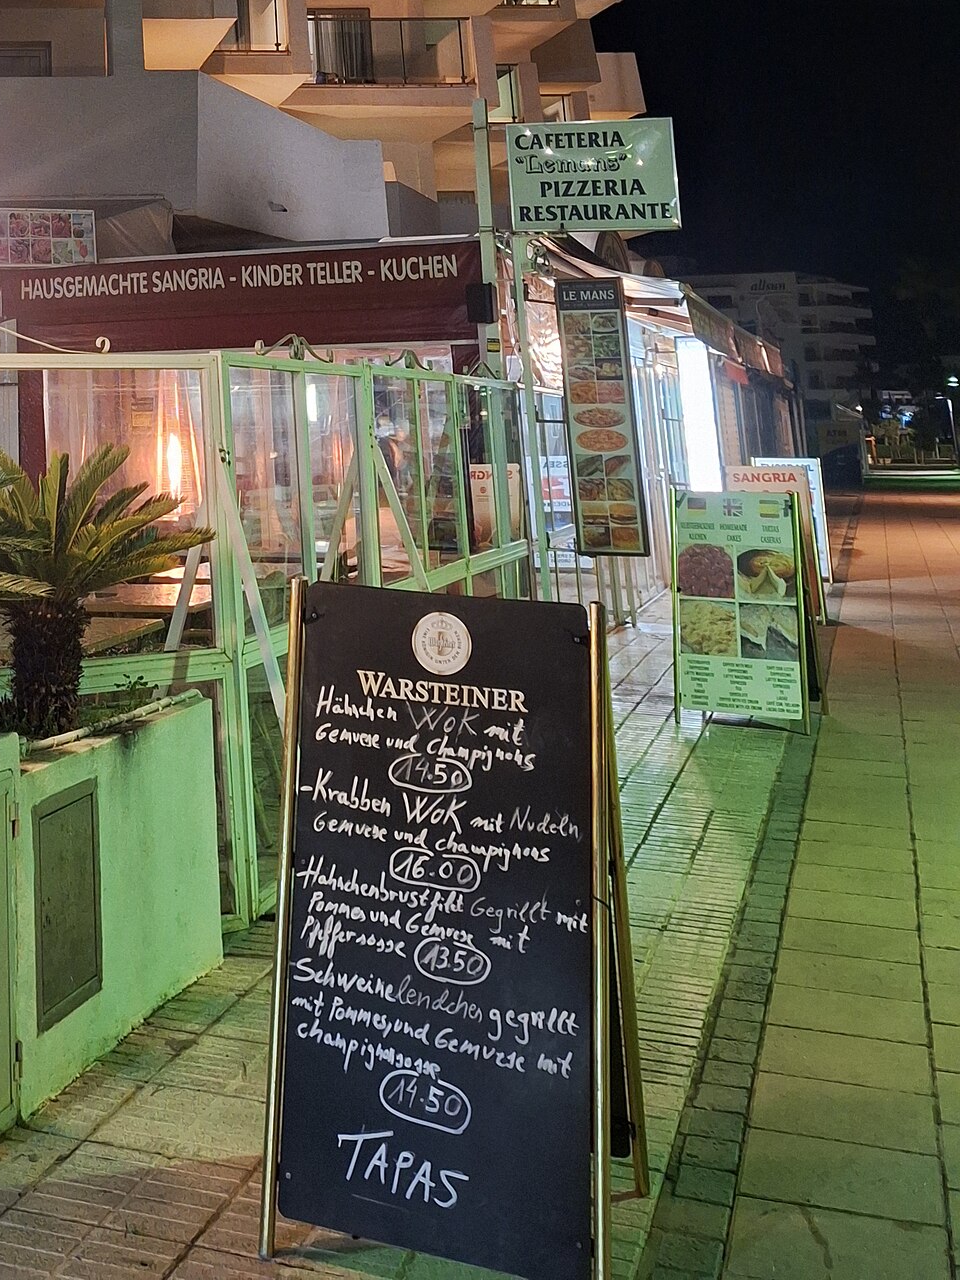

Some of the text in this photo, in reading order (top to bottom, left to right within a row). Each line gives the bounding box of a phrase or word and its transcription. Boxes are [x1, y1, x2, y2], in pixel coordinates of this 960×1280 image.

[514, 131, 625, 150] CAFETERIA
[540, 179, 647, 198] PIZZERIA
[519, 202, 673, 222] RESTAURANTE
[20, 271, 148, 301] HAUSGEMACHTE
[152, 266, 225, 292] SANGRIA
[241, 263, 304, 288] KINDER
[306, 260, 363, 285] TELLER
[380, 254, 458, 282] KUCHEN
[563, 289, 615, 301] LE MANS
[733, 472, 797, 483] SANGRIA
[356, 669, 529, 713] WARSTEINER
[386, 733, 420, 753] und
[483, 718, 524, 746] mit
[394, 757, 464, 785] 14.50
[470, 813, 503, 833] mit
[394, 828, 429, 850] und
[394, 853, 474, 885] 16.00
[370, 910, 402, 929] und
[489, 924, 531, 954] mit
[556, 905, 588, 933] mit
[420, 946, 485, 975] 13.50
[291, 990, 324, 1017] mit
[537, 1051, 574, 1079] mit
[388, 1077, 462, 1116] 14.50
[337, 1129, 470, 1208] TAPAS
